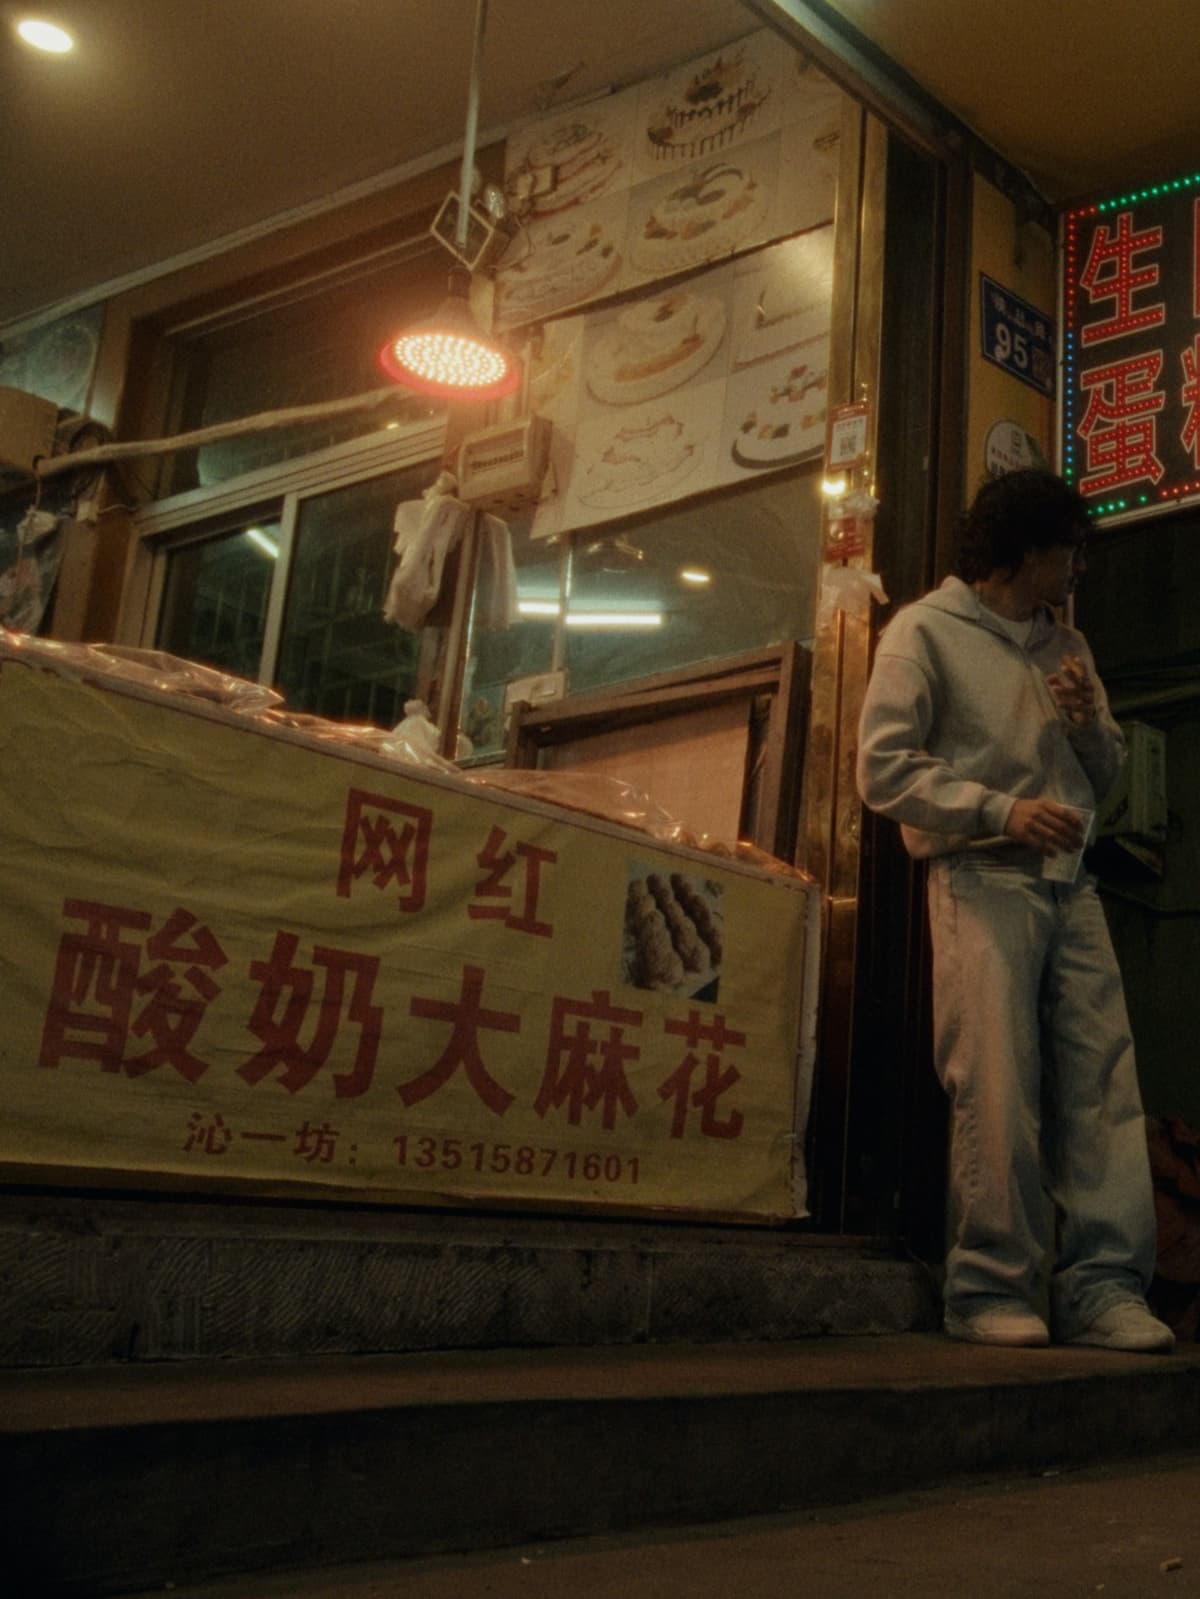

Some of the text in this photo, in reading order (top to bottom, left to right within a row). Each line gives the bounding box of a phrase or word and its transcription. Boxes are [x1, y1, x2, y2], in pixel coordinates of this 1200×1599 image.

[993, 321, 1029, 369] 95
[337, 788, 559, 938] 网红
[38, 898, 747, 1141] 酸奶大麻花
[392, 1134, 642, 1185] 13515871601
